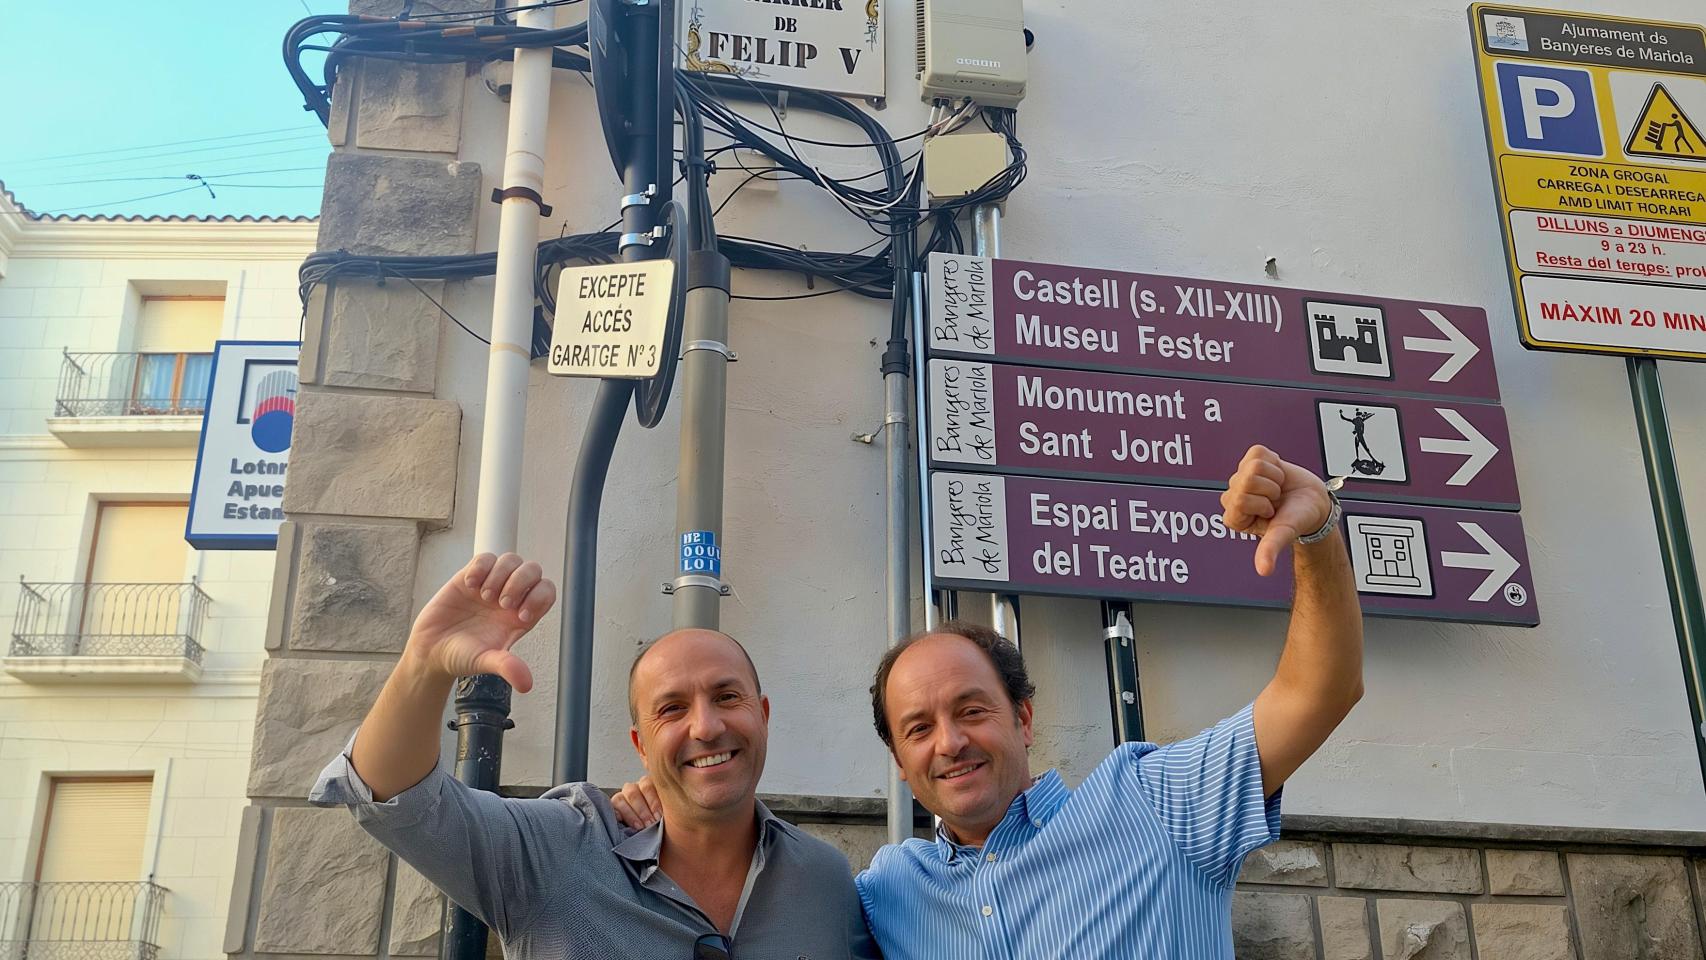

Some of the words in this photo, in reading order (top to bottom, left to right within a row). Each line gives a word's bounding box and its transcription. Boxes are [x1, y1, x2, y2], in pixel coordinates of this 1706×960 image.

[708, 31, 818, 69] FELIP
[838, 47, 862, 75] V
[1540, 37, 1612, 56] Banyeres
[1616, 45, 1635, 59] de
[1638, 47, 1695, 65] Mariola
[1517, 75, 1576, 140] P
[1537, 178, 1604, 194] CARREGA
[1568, 165, 1610, 179] ZONA
[1596, 198, 1634, 212] LIMIT
[1637, 202, 1691, 216] HORARI
[1537, 216, 1609, 233] DILLUNS
[1614, 226, 1623, 235] a
[1628, 224, 1706, 242] DIUMENG
[1536, 251, 1582, 266] Resta
[1588, 255, 1611, 269] del
[1601, 240, 1610, 251] 9
[1615, 243, 1624, 253] a
[1628, 242, 1646, 254] 23
[579, 273, 646, 299] EXCEPTE
[935, 260, 968, 342] Banyeres
[1013, 270, 1119, 309] Castell
[1129, 281, 1165, 319] (s.
[1175, 285, 1283, 333] XII-XIII)
[1540, 300, 1623, 325] MÀXIM
[1629, 309, 1656, 327] 20
[582, 303, 632, 333] ACCÉS
[963, 325, 991, 349] de
[1015, 313, 1119, 353] Museu
[1138, 326, 1234, 363] Fester
[552, 344, 620, 368] GARATGE
[647, 344, 657, 368] 3
[937, 366, 970, 453] Banyeres
[1017, 375, 1186, 420] Monument
[1204, 398, 1222, 422] a
[965, 434, 994, 460] de
[1019, 422, 1093, 459] Sant
[1111, 430, 1193, 466] Jordi
[941, 480, 977, 565] Banyeres
[972, 482, 999, 546] Mariola
[1030, 493, 1119, 536] Espai
[1129, 500, 1256, 543] Expos
[972, 549, 1001, 573] de
[1032, 542, 1080, 576] del
[1090, 545, 1189, 584] Teatre
